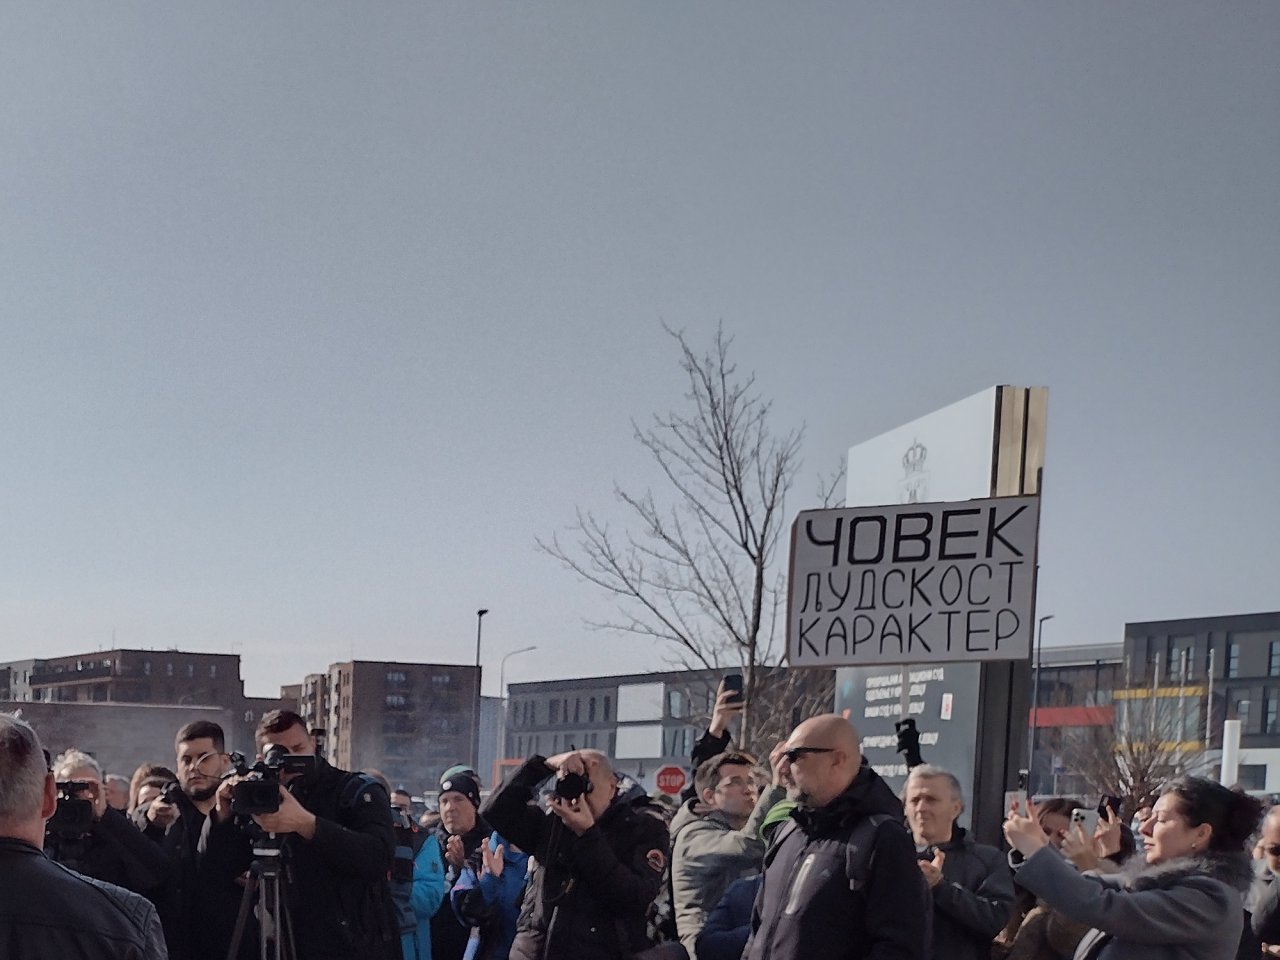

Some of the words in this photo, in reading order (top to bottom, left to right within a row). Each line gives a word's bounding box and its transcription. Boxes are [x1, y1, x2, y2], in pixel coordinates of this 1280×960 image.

[806, 505, 1028, 567] ЧОВЕК
[798, 608, 1020, 657] КАРАКТЕР
[659, 774, 684, 787] STOP
